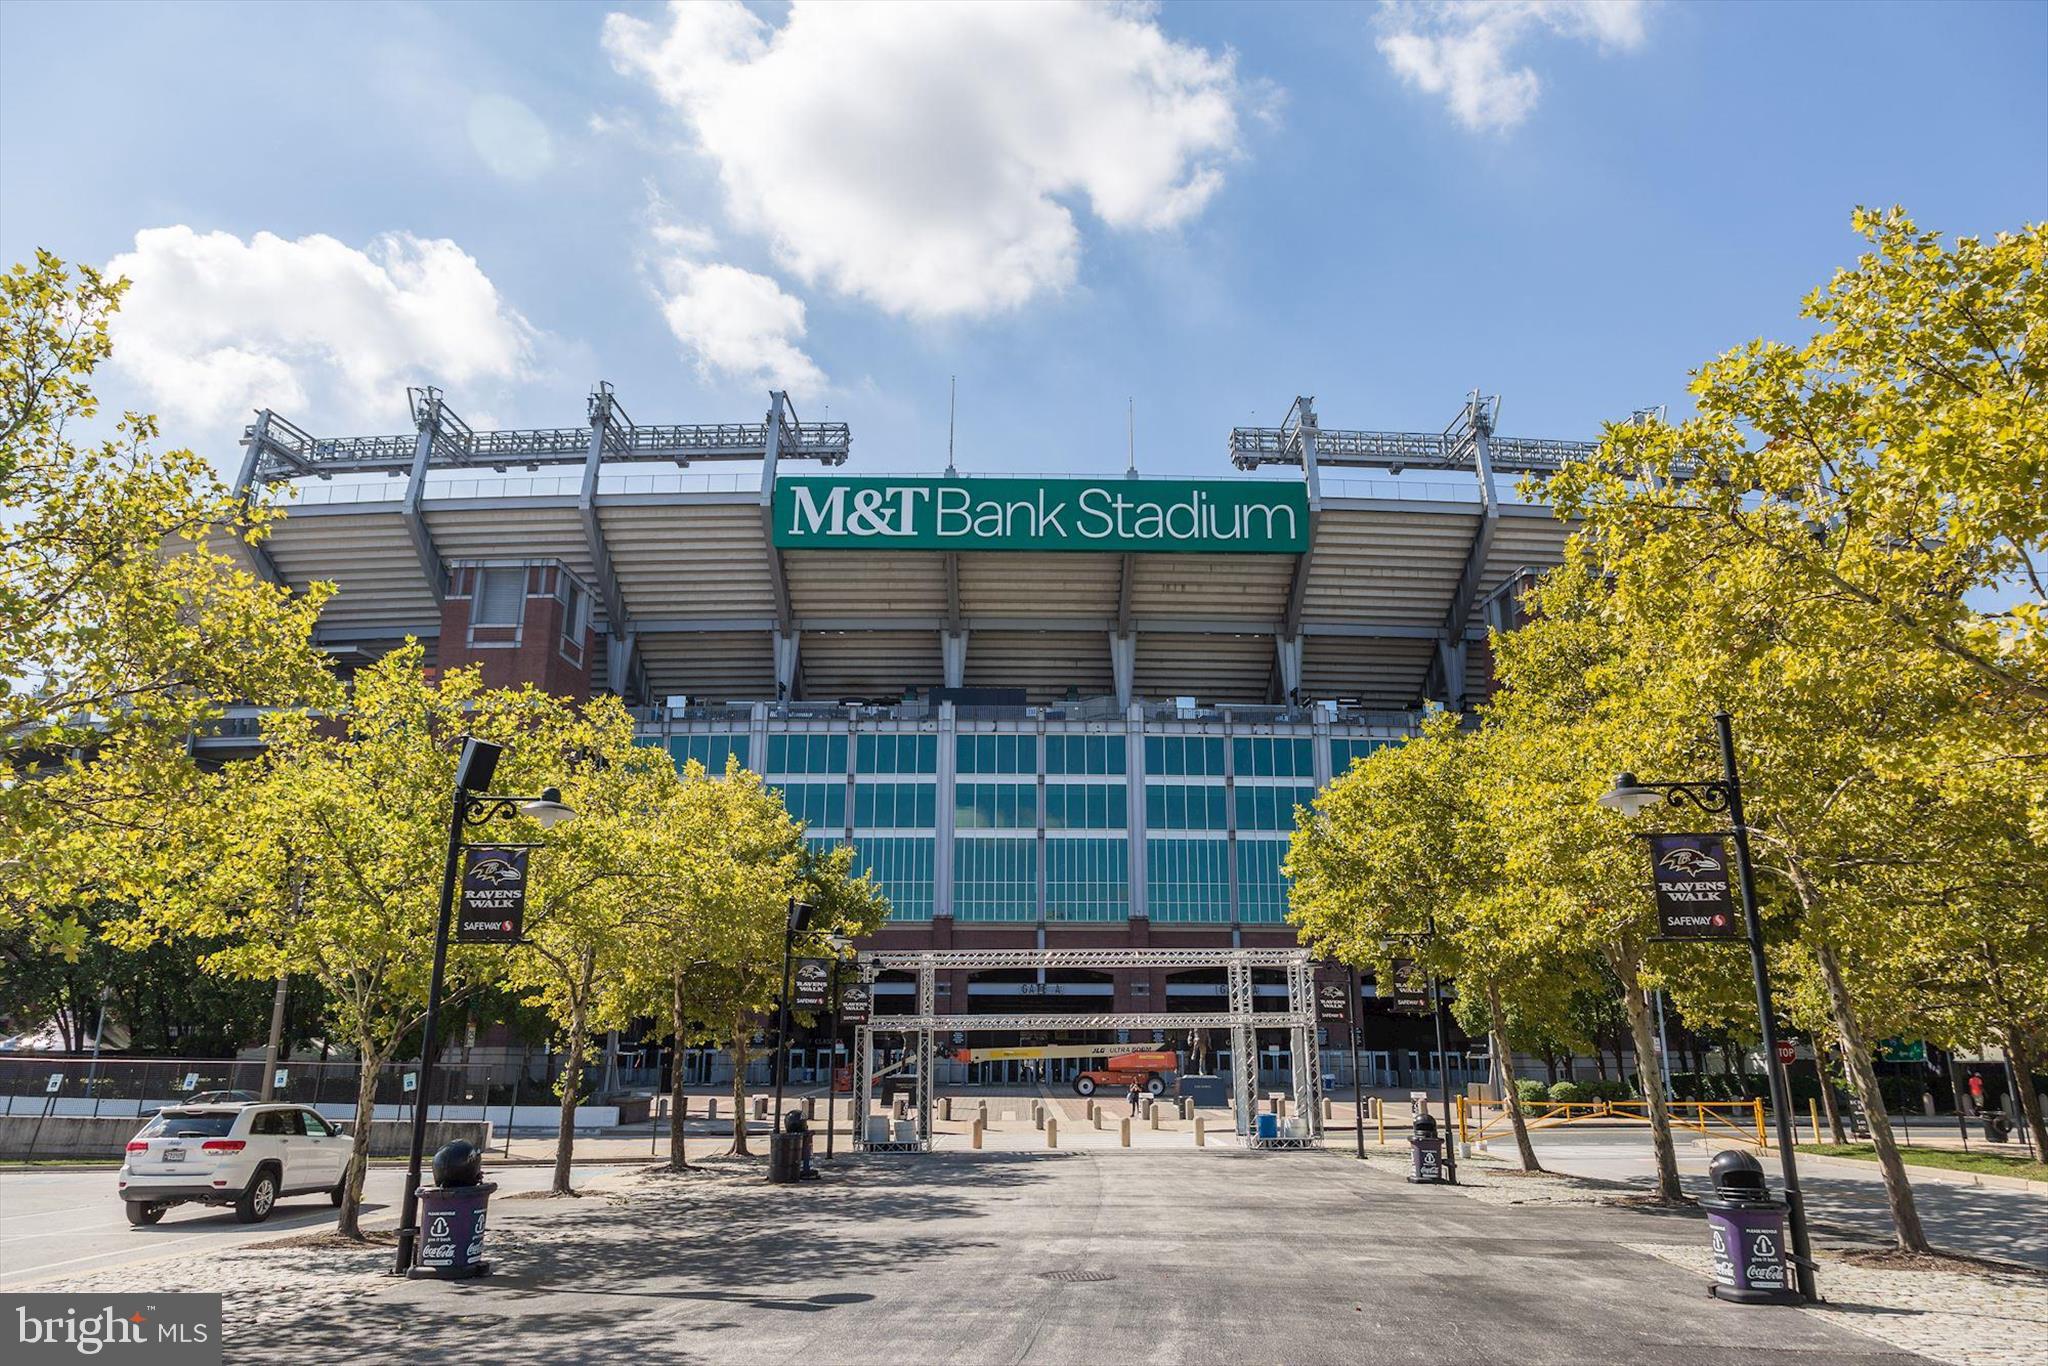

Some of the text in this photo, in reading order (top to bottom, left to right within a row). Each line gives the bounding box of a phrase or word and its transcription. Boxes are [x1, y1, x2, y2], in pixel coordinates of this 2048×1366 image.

[788, 486, 1296, 540] M&T Bank Stadium
[1659, 881, 1727, 892] RAVENS
[465, 890, 522, 899] RAVENS
[1667, 892, 1721, 901] WALK
[469, 900, 514, 908] WALK
[464, 921, 502, 931] SAFEWAY
[1668, 916, 1712, 926] SAFEWAY
[1023, 984, 1047, 994] GATE
[1778, 1047, 1794, 1058] TOP
[422, 1244, 456, 1258] Coca-Cola
[1747, 1265, 1784, 1279] Coca-Cola
